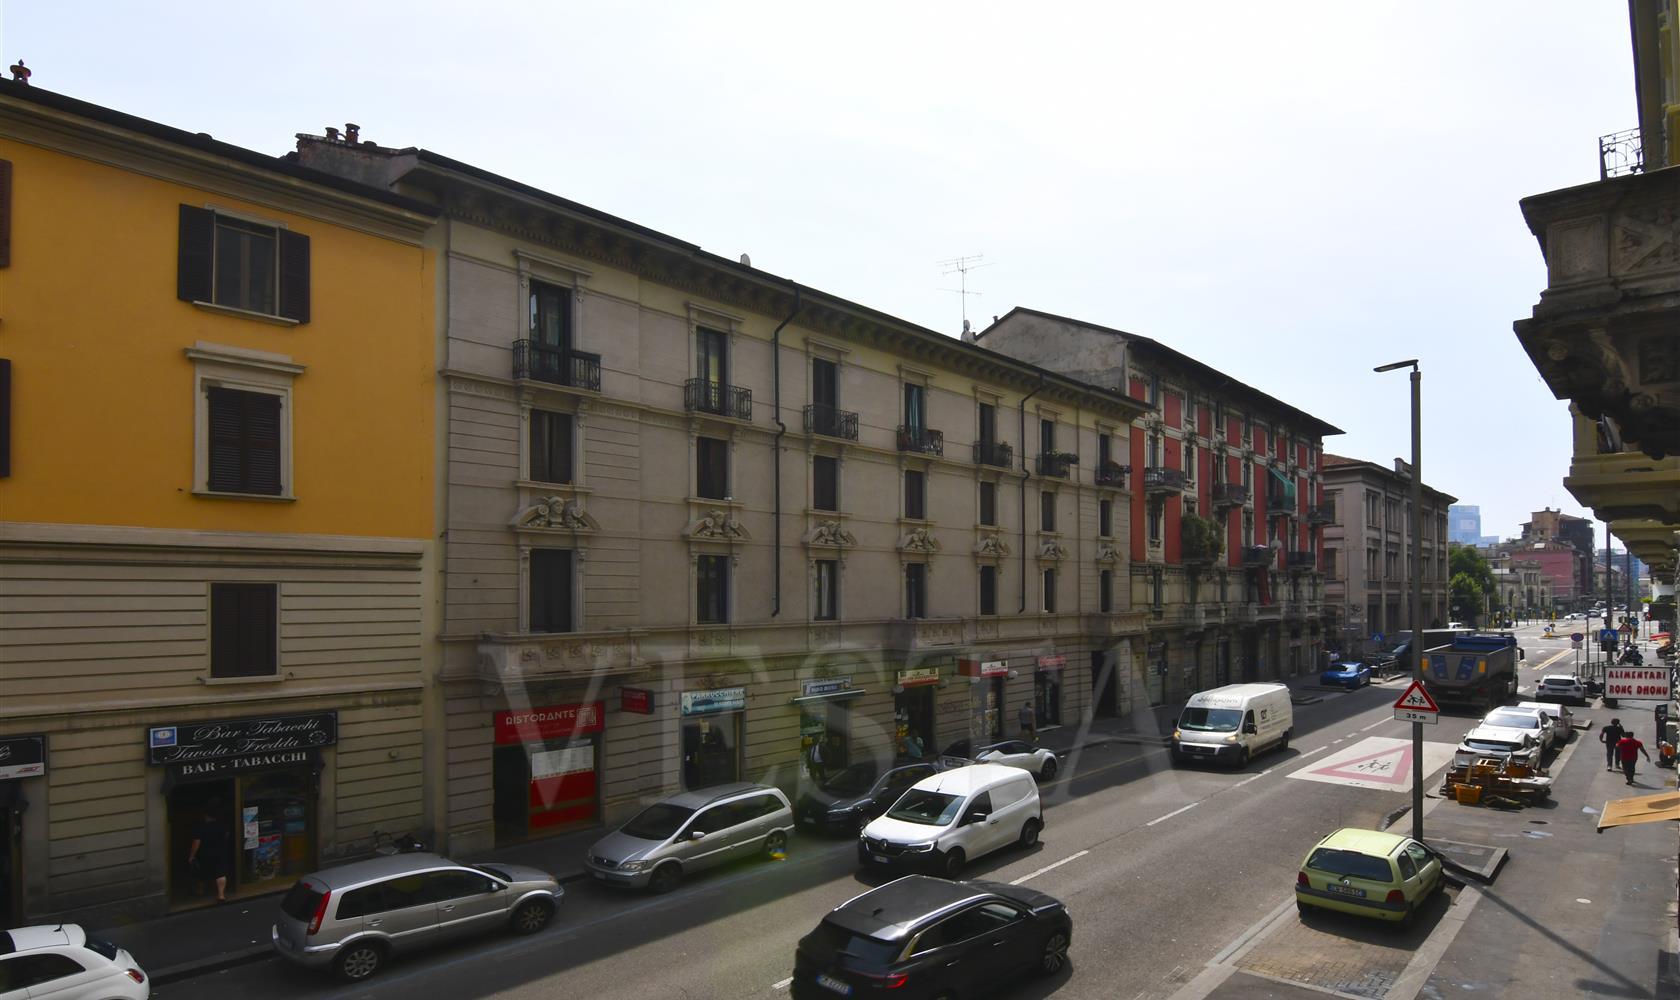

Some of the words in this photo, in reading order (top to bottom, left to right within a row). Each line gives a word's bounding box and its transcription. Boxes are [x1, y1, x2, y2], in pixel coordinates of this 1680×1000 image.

[1608, 670, 1666, 680] ALIMENTARI
[505, 709, 576, 725] RISTORANTE
[193, 725, 242, 740] Bar
[246, 719, 320, 736] Tabacchi
[164, 743, 230, 761] Tavola
[233, 737, 299, 753] Fredda
[182, 762, 215, 775] BAR
[231, 751, 307, 769] TABACCHI
